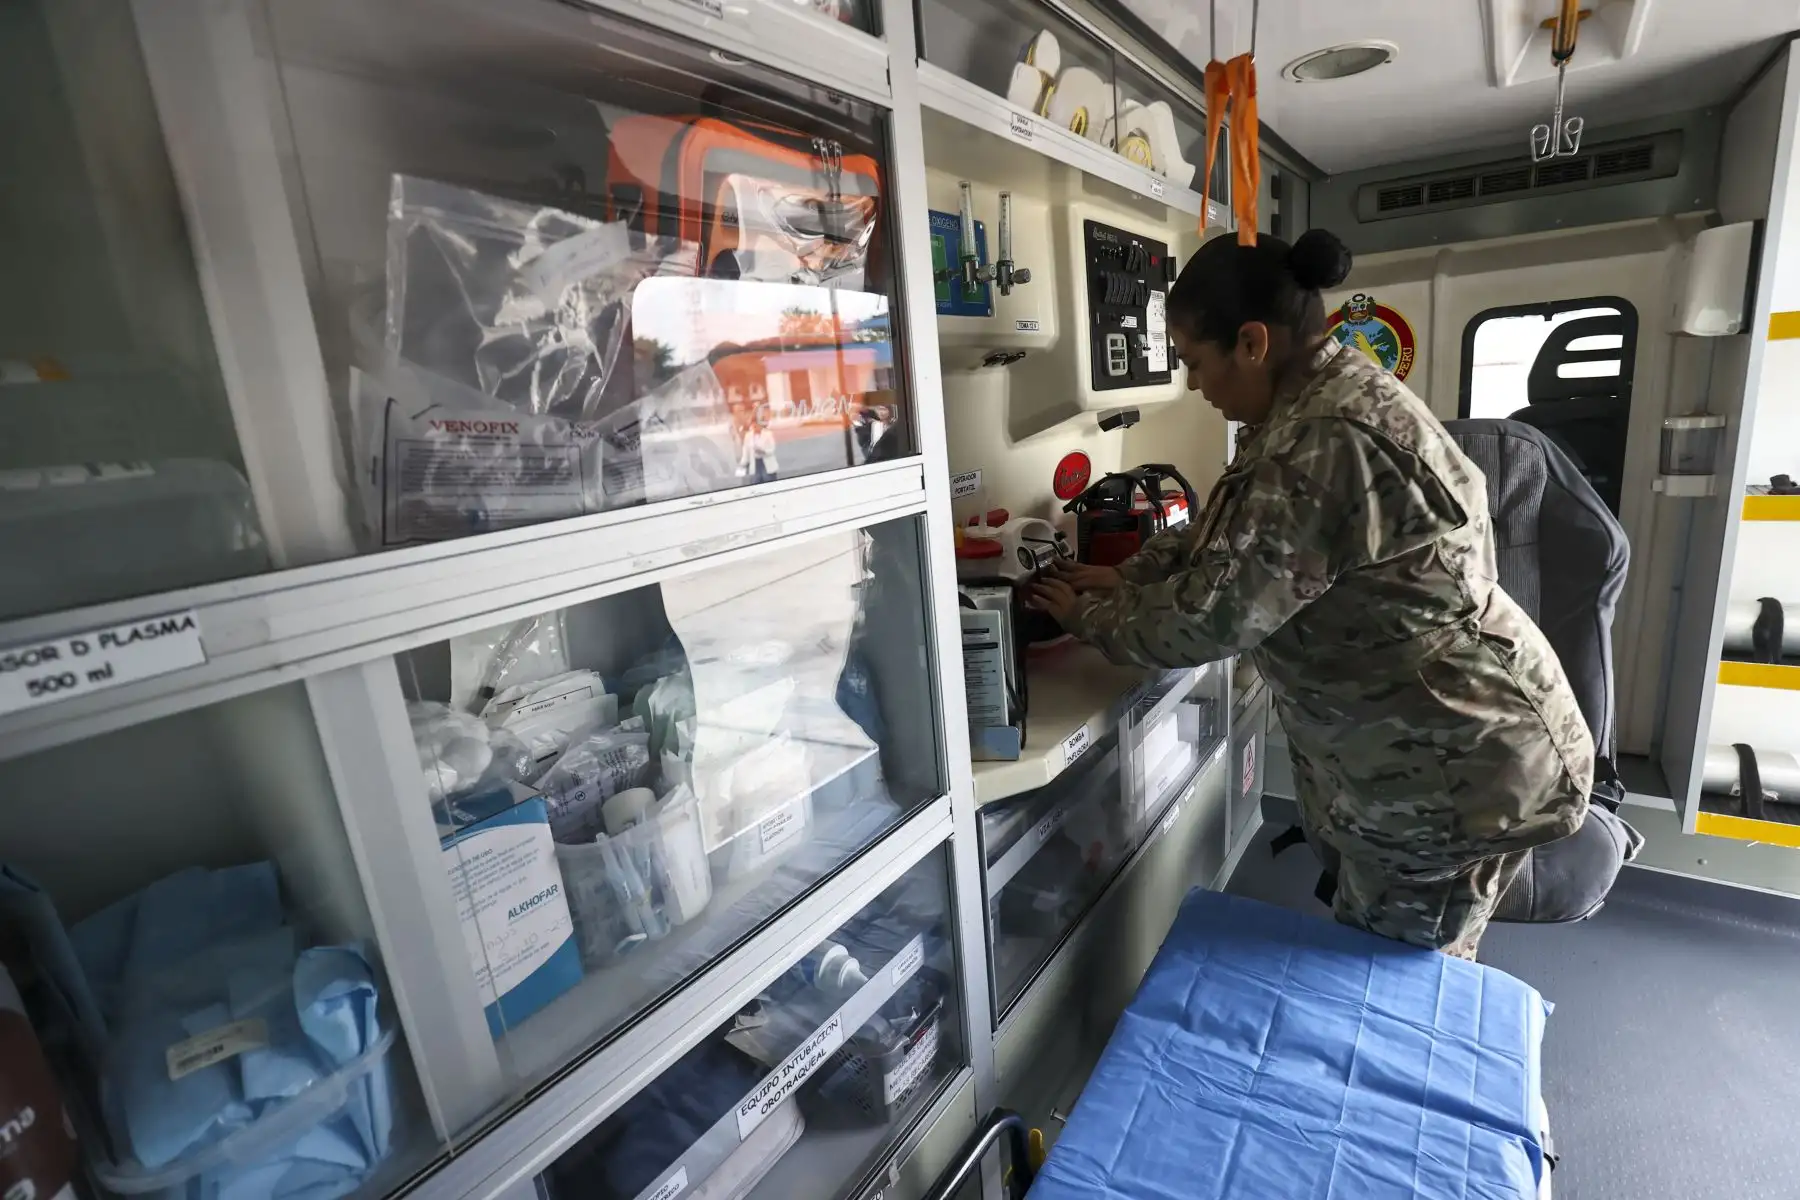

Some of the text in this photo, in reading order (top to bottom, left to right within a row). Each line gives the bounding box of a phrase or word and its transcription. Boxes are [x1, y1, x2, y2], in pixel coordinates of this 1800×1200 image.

[1396, 347, 1413, 377] PERU
[428, 419, 520, 435] VENOFIX
[952, 472, 977, 485] ASPIRADOR
[0, 615, 196, 672] SOR D PLASMA
[26, 661, 114, 698] 500 ml
[1069, 731, 1084, 748] BOMBA
[507, 884, 559, 920] ALKHOFAR
[741, 1019, 839, 1116] EQUIPO INTUBACION
[761, 1048, 827, 1115] OROTRAQUEAL
